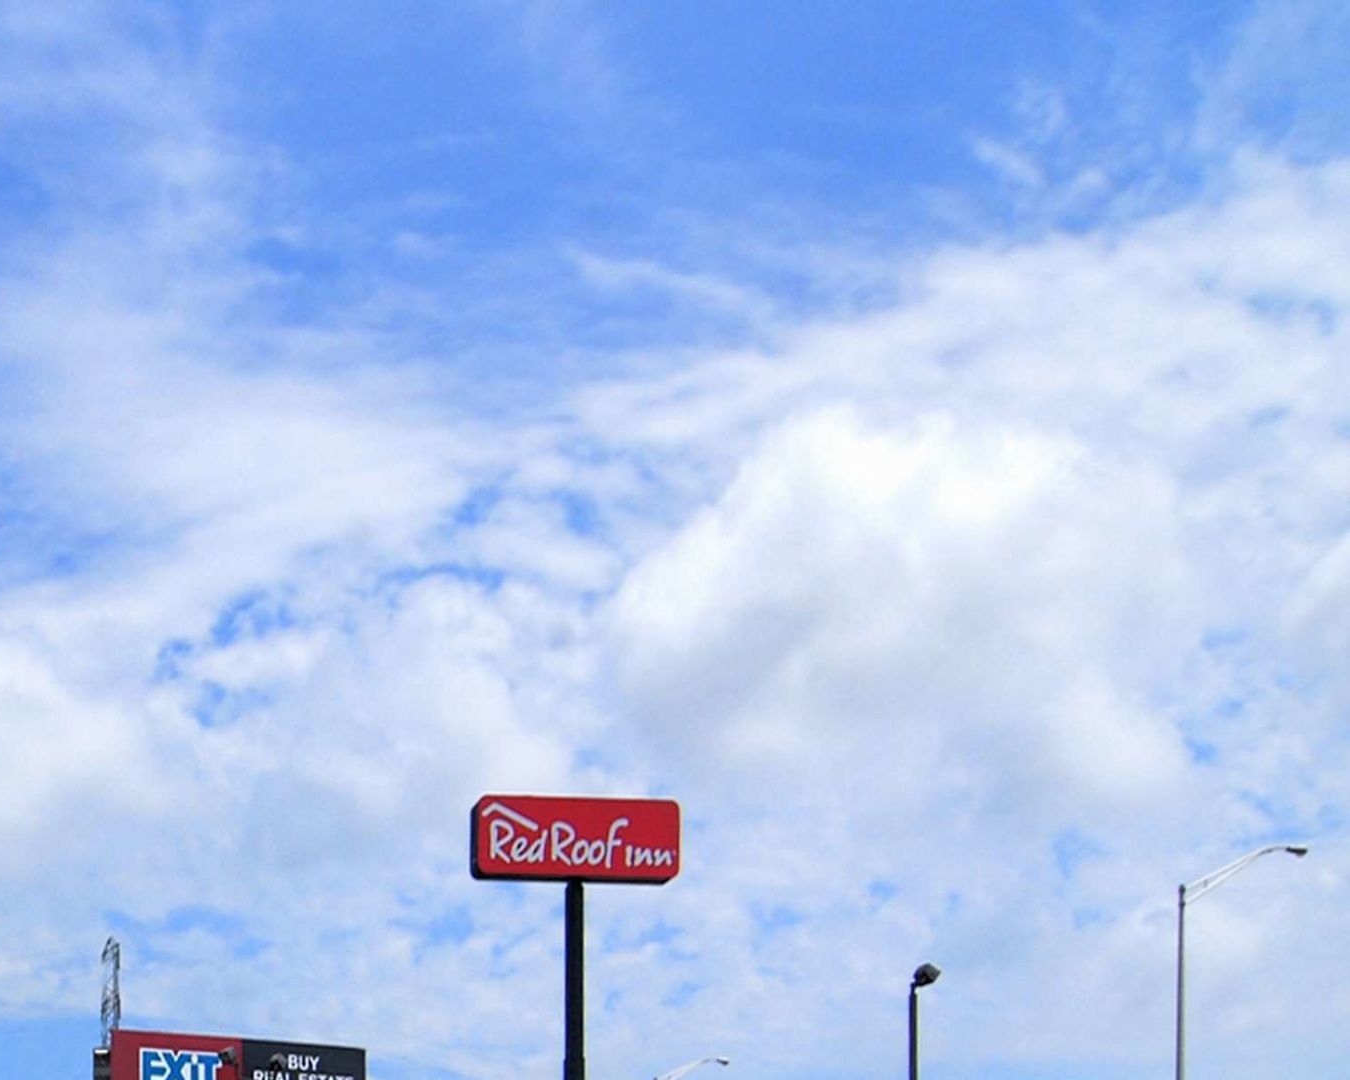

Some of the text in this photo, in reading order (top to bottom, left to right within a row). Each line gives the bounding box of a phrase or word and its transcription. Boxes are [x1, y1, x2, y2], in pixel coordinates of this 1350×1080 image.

[489, 818, 549, 864] Red
[551, 816, 629, 869] Roof
[288, 1053, 319, 1071] BUY
